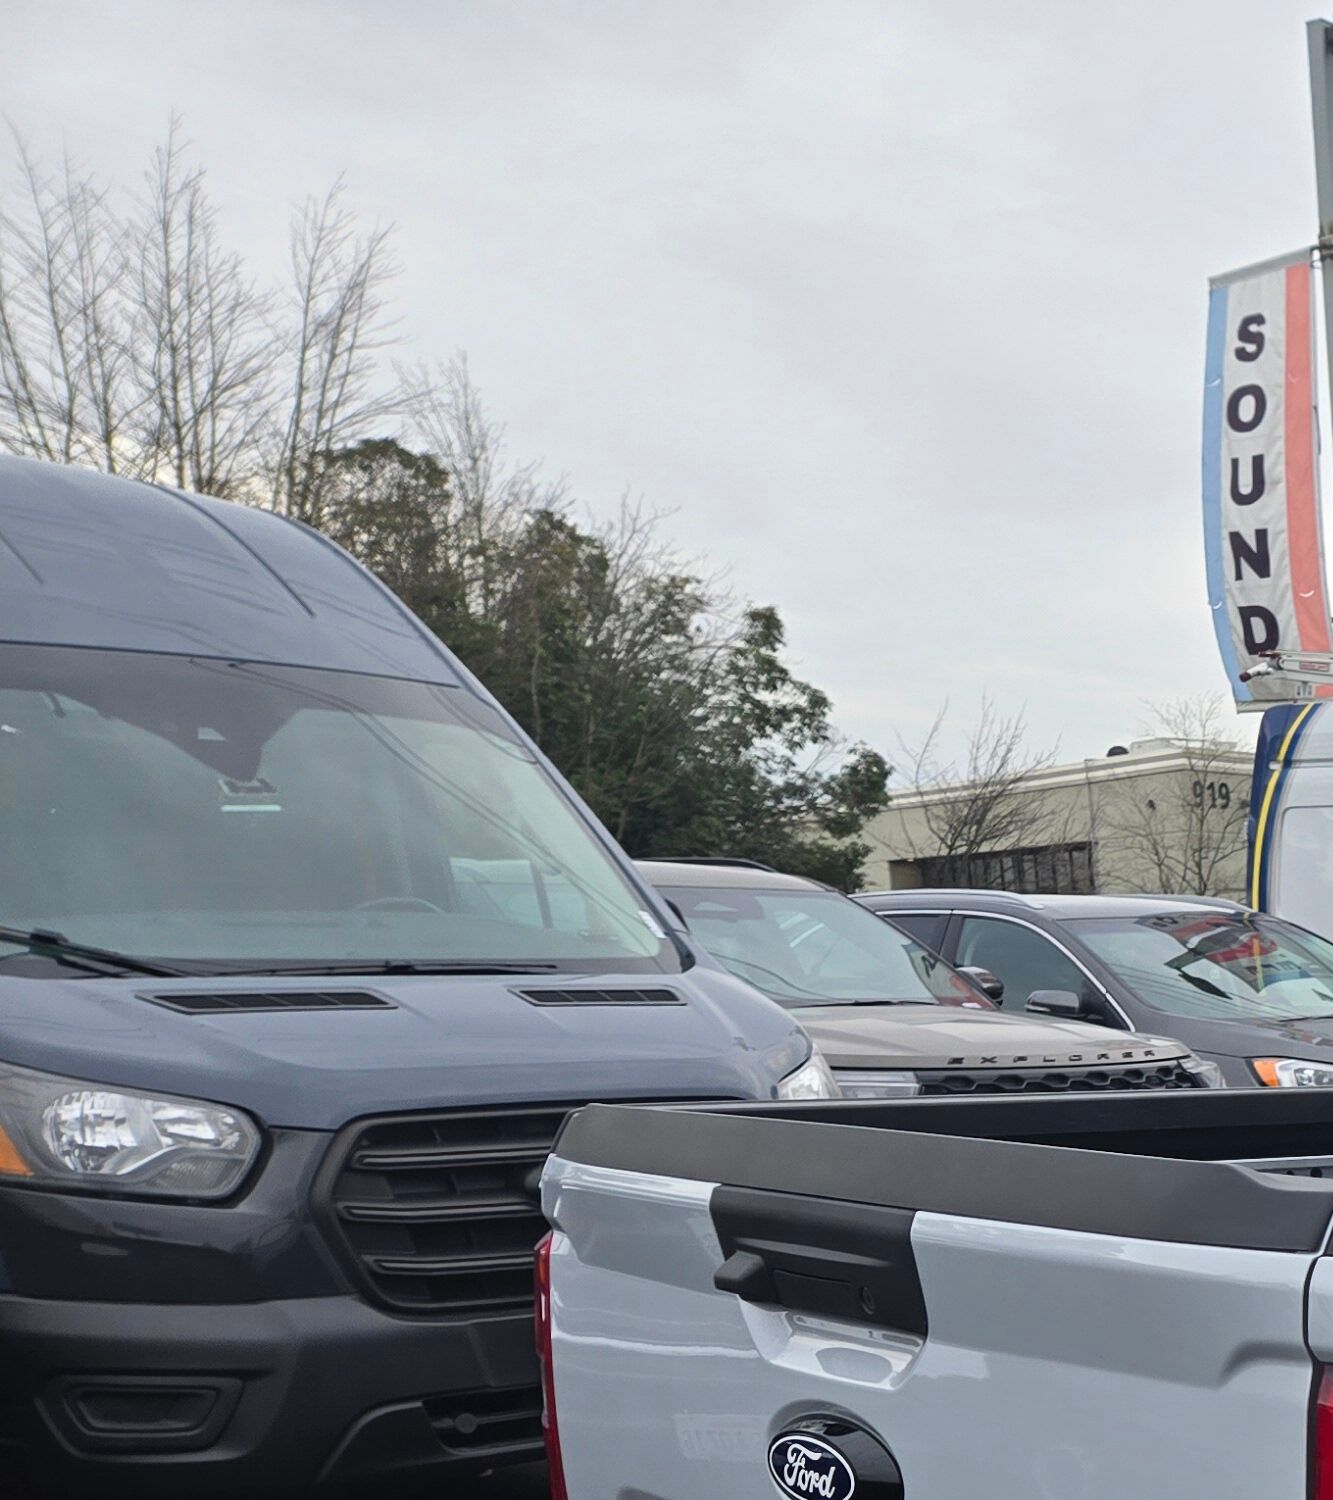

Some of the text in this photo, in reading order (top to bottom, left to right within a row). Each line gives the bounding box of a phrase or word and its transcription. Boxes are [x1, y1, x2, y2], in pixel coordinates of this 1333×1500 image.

[1226, 312, 1280, 656] SOUND
[1192, 780, 1231, 810] 919
[947, 1050, 1156, 1065] EXPLORER
[783, 1443, 836, 1499] Ford
